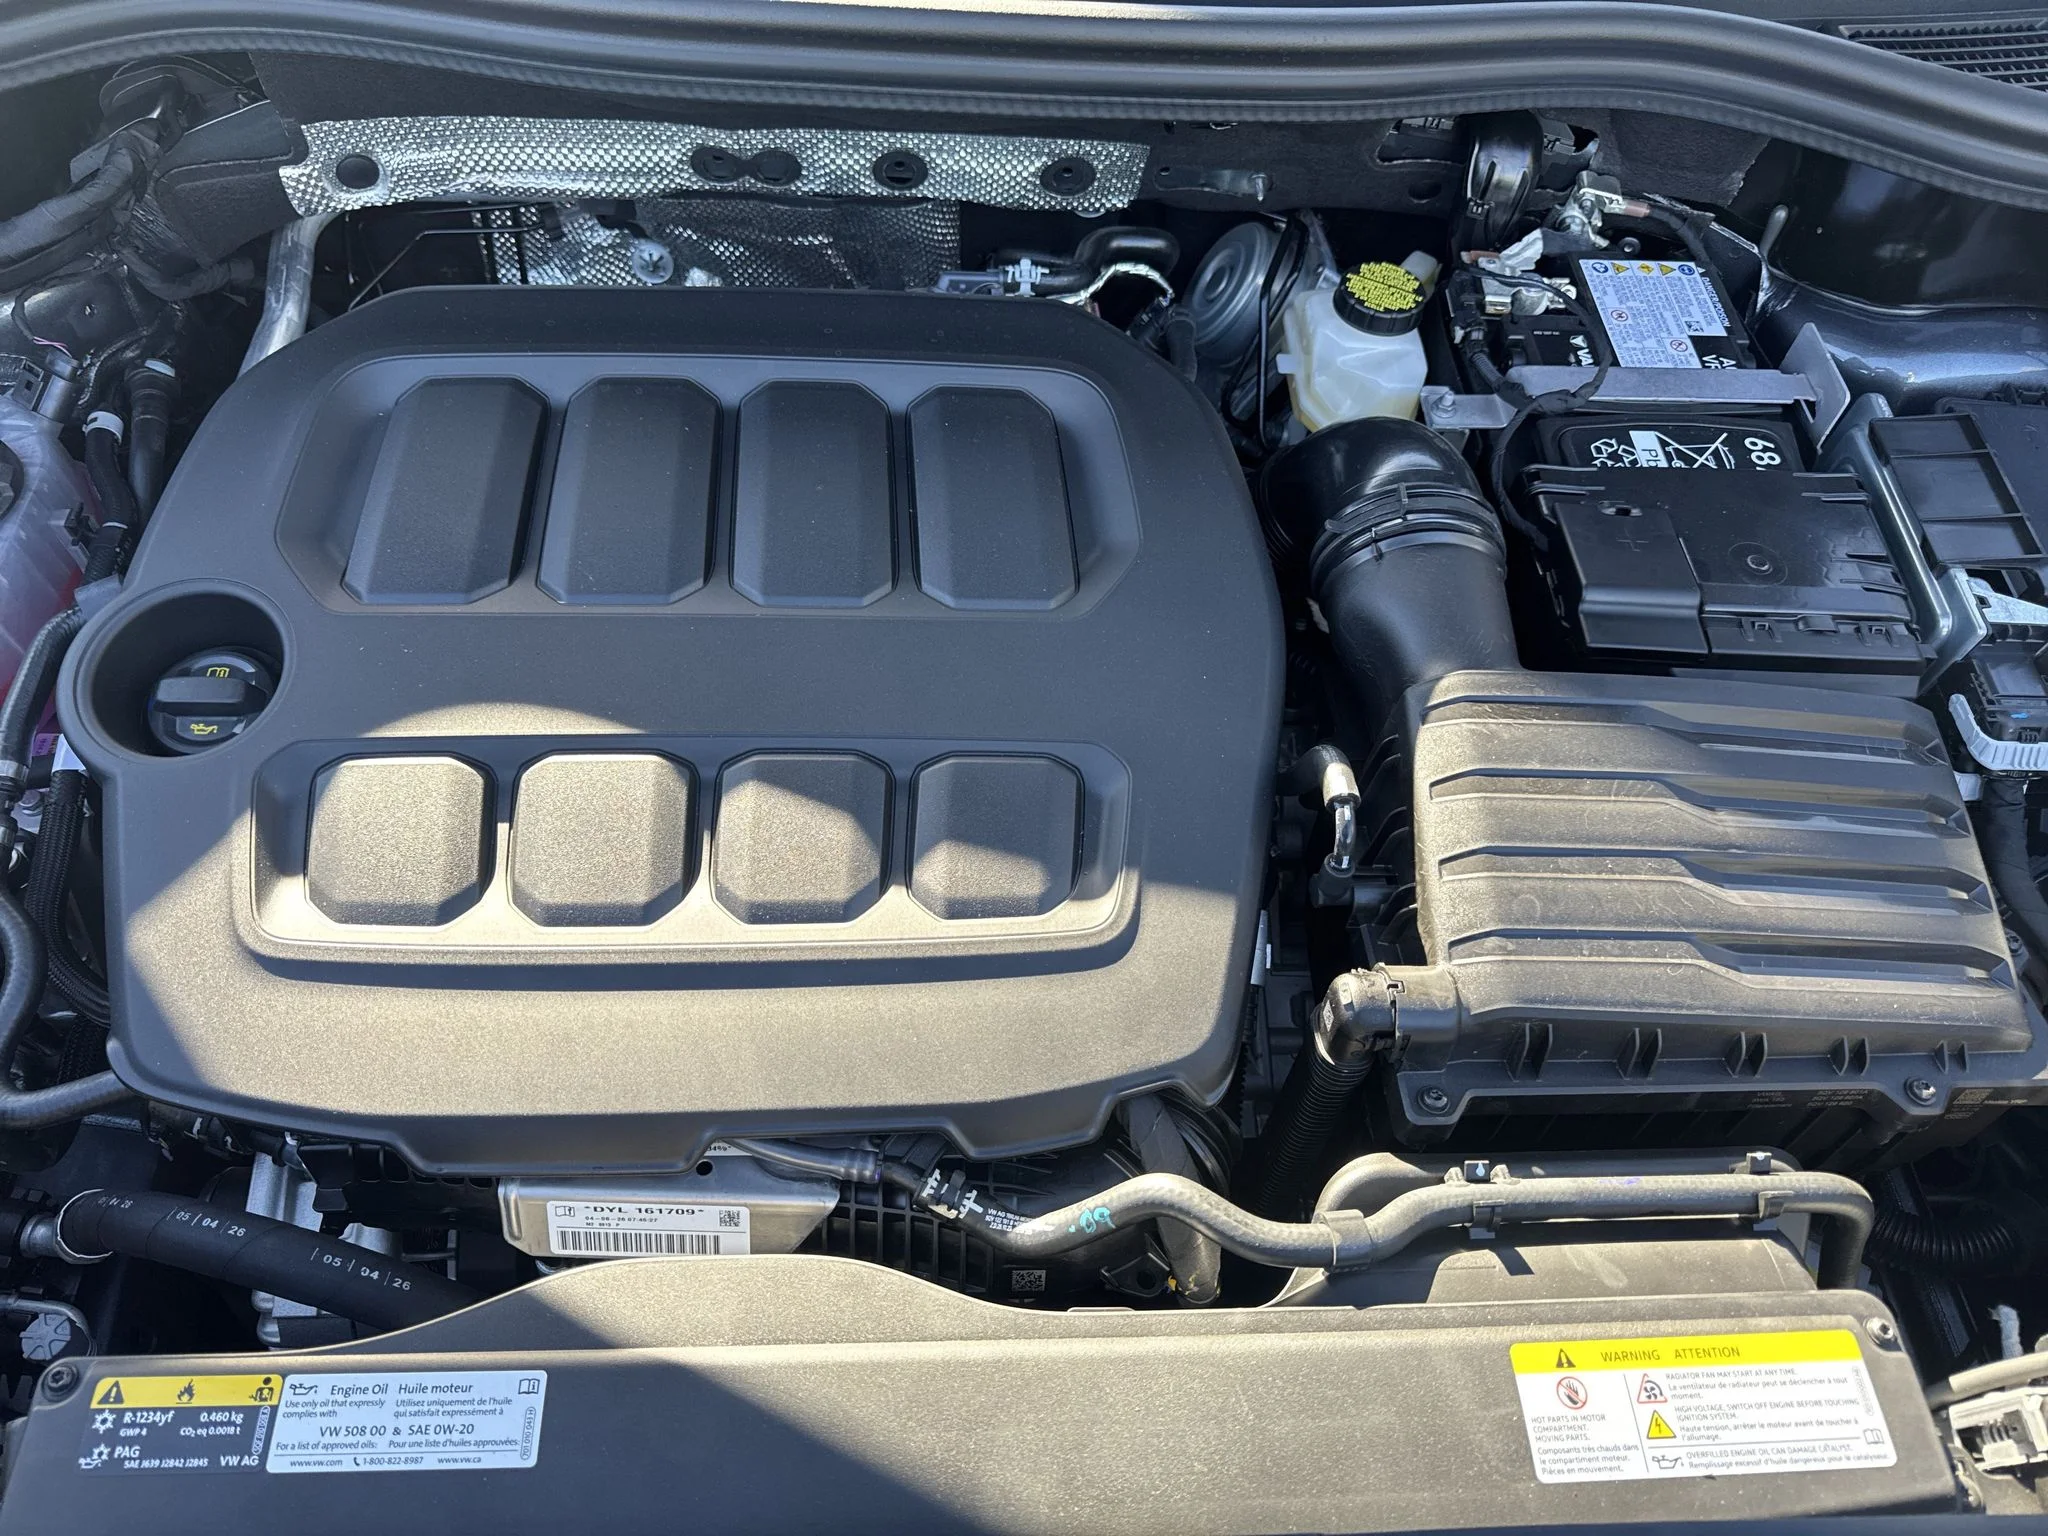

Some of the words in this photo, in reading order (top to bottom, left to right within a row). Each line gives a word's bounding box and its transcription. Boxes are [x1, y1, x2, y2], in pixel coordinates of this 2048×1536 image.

[1577, 348, 1594, 367] VA
[1744, 437, 1781, 470] 68
[1601, 1349, 1660, 1362] WARNING
[1674, 1346, 1740, 1360] ATTENTION
[1666, 1372, 1700, 1380] RADIATOR
[1716, 1370, 1732, 1378] MAY
[1732, 1370, 1753, 1378] START
[1764, 1368, 1778, 1376] ANY
[330, 1384, 370, 1398] Engine
[372, 1383, 388, 1395] Oil
[398, 1382, 429, 1394] Huile
[431, 1384, 474, 1394] moteur
[285, 1400, 300, 1408] Use
[301, 1400, 318, 1410] only
[320, 1400, 330, 1408] oil
[331, 1399, 348, 1408] that
[349, 1398, 386, 1409] expressly
[396, 1398, 425, 1408] Utilisez
[426, 1398, 475, 1408] uniquement
[477, 1397, 487, 1406] de
[488, 1396, 512, 1406] l'huile
[123, 1410, 175, 1426] R-1234yf
[200, 1411, 230, 1422] 0.460
[230, 1410, 244, 1424] kg
[282, 1410, 318, 1420] complies
[320, 1409, 338, 1418] with
[394, 1408, 408, 1419] qui
[408, 1407, 440, 1418] satisfait
[442, 1406, 497, 1418] expressément
[498, 1407, 504, 1416] à
[1677, 1414, 1708, 1422] IGNITION
[1531, 1416, 1546, 1424] HOT
[1548, 1415, 1570, 1423] PARTS
[1580, 1414, 1606, 1422] MOTOR
[120, 1427, 140, 1437] GWP
[141, 1427, 148, 1436] 4
[196, 1428, 208, 1438] eq
[208, 1426, 235, 1435] 0.0018
[320, 1426, 342, 1437] VW
[344, 1425, 368, 1437] 508
[370, 1425, 386, 1436] 00
[392, 1426, 402, 1436] &
[408, 1424, 430, 1436] SAE
[433, 1424, 474, 1436] 0W-20
[388, 1440, 407, 1448] Pour
[424, 1438, 440, 1448] liste
[442, 1438, 472, 1448] d'huiles
[1535, 1434, 1564, 1443] MOVING
[114, 1445, 141, 1458] PAG
[276, 1442, 290, 1450] For
[297, 1441, 310, 1450] list
[311, 1441, 320, 1450] of
[321, 1440, 360, 1452] approved
[360, 1440, 378, 1449] oils:
[1538, 1446, 1580, 1455] Composants
[1582, 1445, 1596, 1453] très
[1596, 1444, 1621, 1452] chauds
[1622, 1443, 1640, 1451] dans
[124, 1460, 140, 1469] SAE
[220, 1455, 240, 1466] VW
[241, 1455, 260, 1466] AG
[290, 1459, 344, 1467] www.vw.com
[363, 1456, 424, 1466] 1-800-822-8987
[437, 1456, 482, 1464] www.vw.ca
[1540, 1457, 1546, 1465] le
[1548, 1456, 1600, 1465] compartiment
